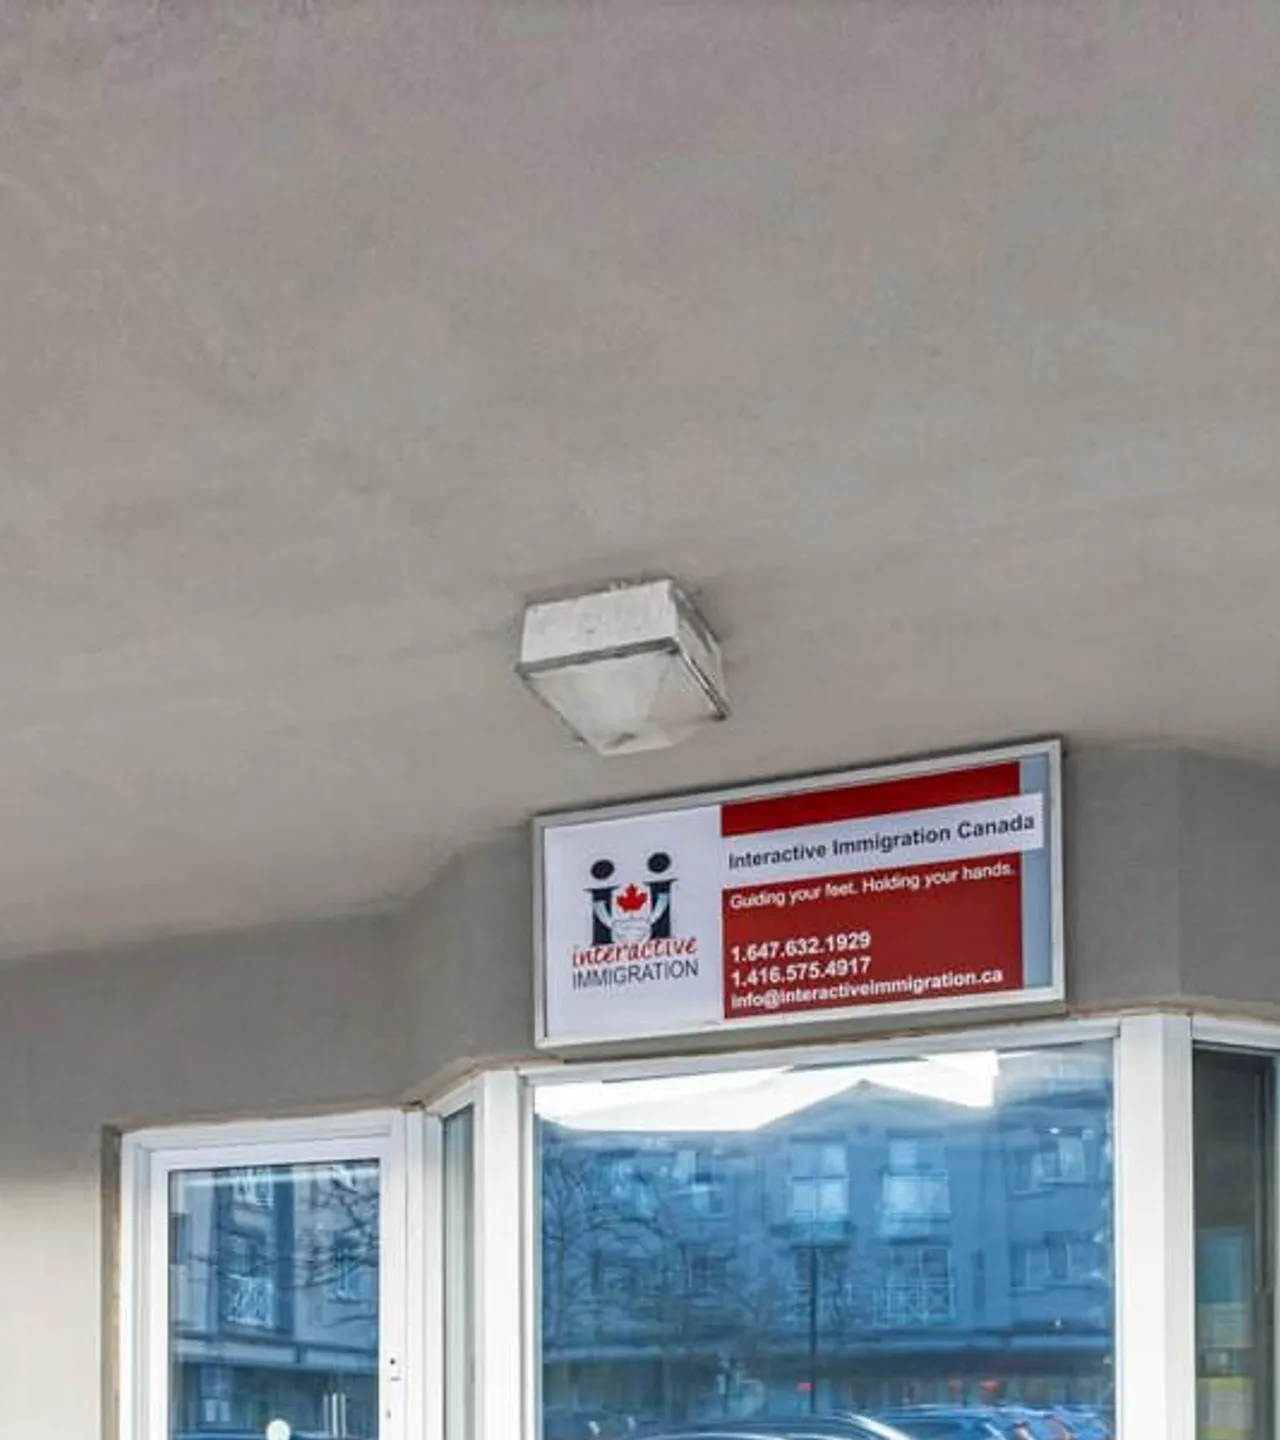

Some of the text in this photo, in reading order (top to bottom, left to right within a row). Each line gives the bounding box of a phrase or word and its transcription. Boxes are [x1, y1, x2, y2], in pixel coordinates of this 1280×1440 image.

[729, 814, 1035, 869] Interactive Immigration Canada
[730, 861, 1015, 910] Guiding your feet. Holding your hands.
[573, 937, 697, 967] interactive
[731, 930, 871, 962] 1.647.632.1929
[573, 959, 699, 991] IMMIGRATION
[731, 956, 871, 987] 1.416.575.4917
[731, 967, 1004, 1009] info@interactiveimmigration.ca
